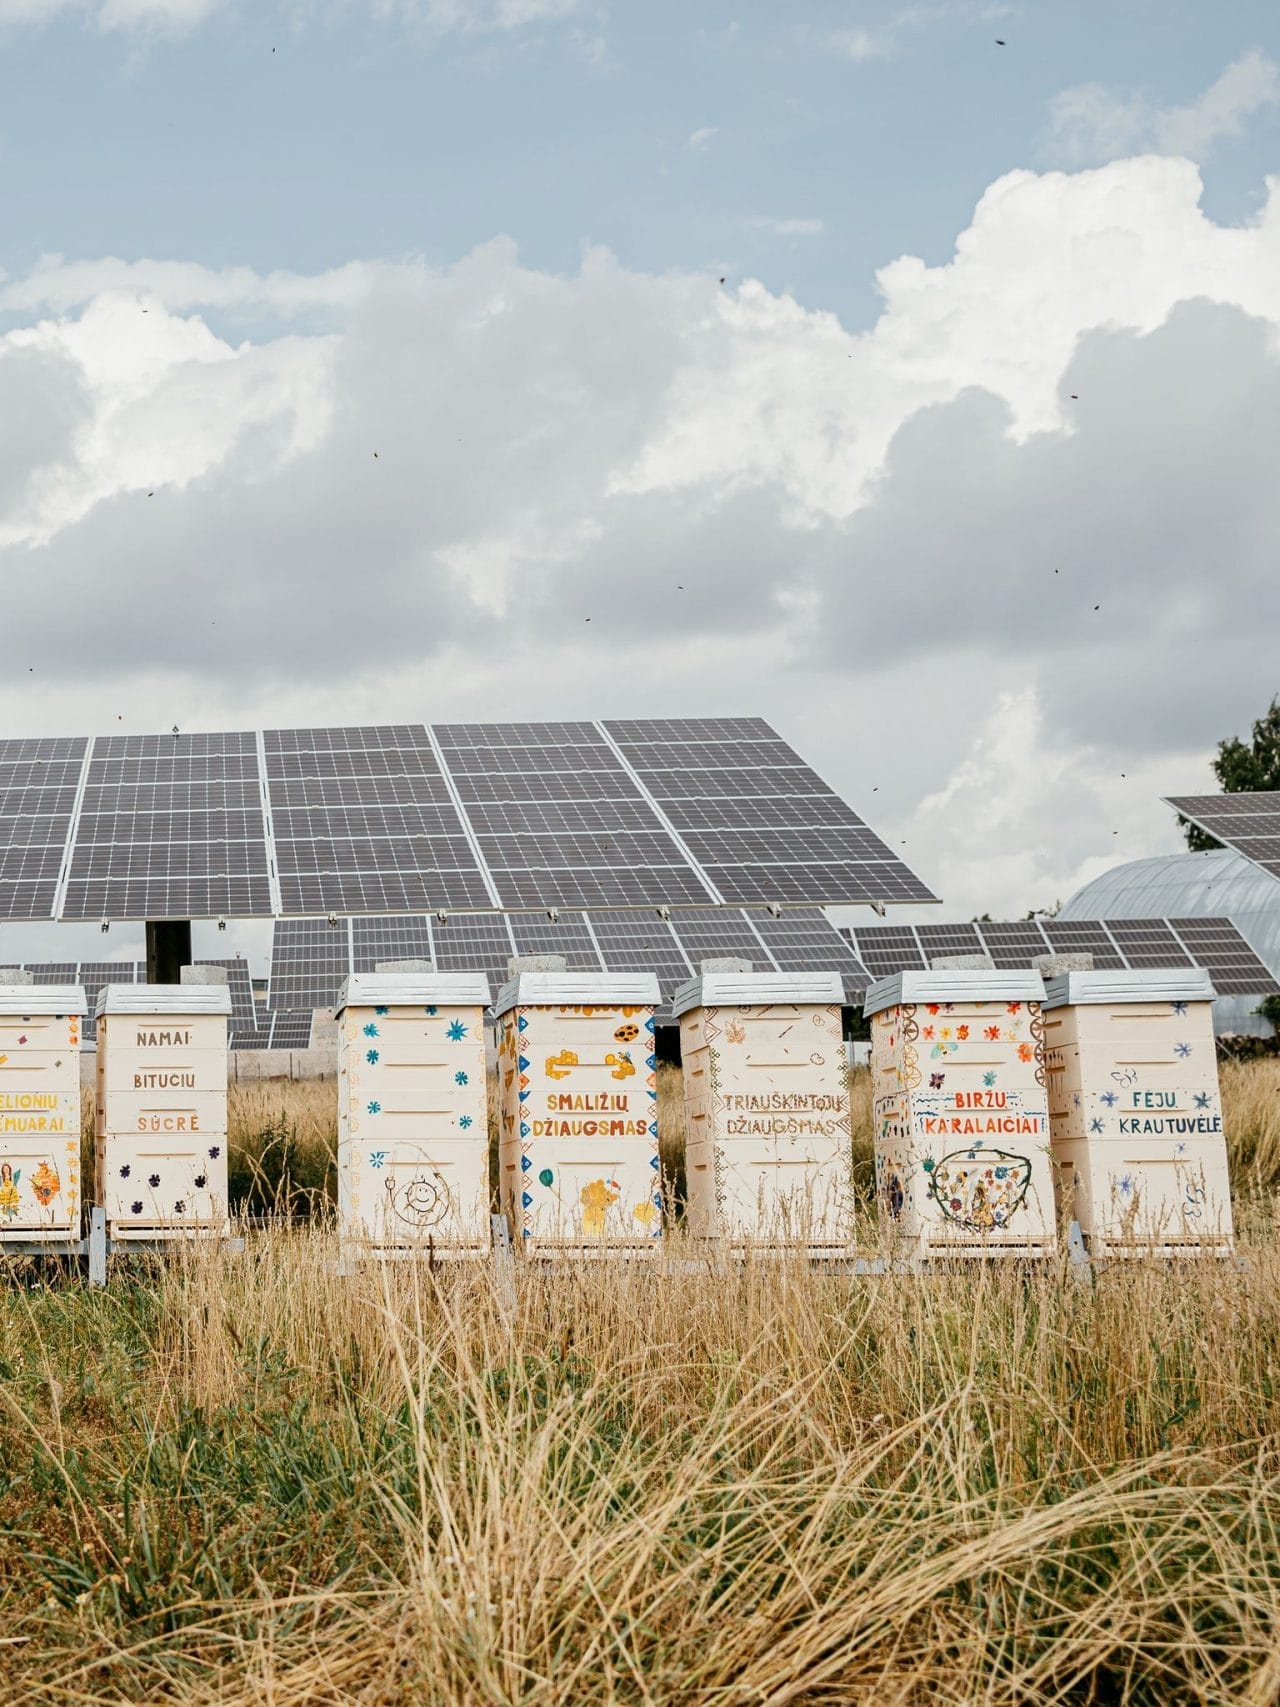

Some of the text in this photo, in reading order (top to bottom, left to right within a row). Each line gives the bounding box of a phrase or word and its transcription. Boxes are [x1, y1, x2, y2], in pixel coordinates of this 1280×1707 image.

[137, 1032, 189, 1046] NAMAI
[547, 1093, 629, 1112] SMALIŽIŲ
[533, 1118, 647, 1136] DŽIAUGSMAS
[926, 1116, 1038, 1133] KARALAIČIAI
